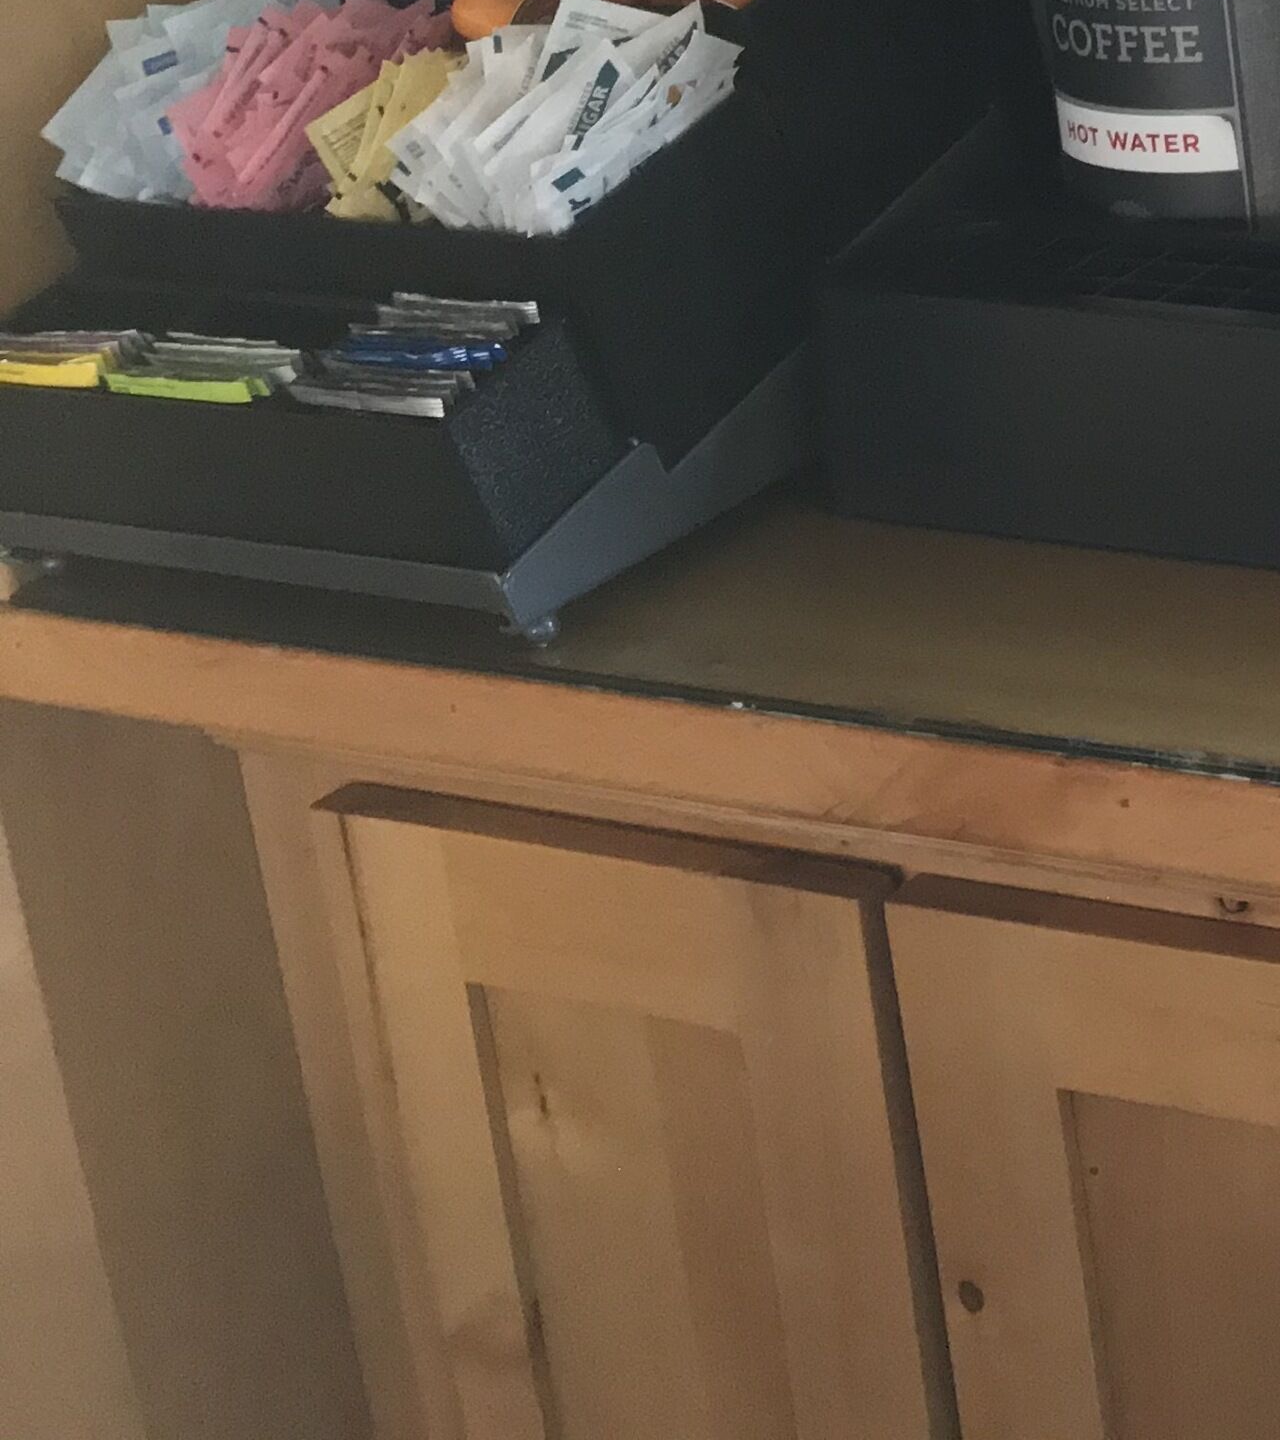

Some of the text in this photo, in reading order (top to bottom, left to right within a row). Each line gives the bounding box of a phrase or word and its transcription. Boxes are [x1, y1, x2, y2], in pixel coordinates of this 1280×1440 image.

[1053, 13, 1204, 63] COFFEE
[1067, 119, 1200, 153] HOT WATER
